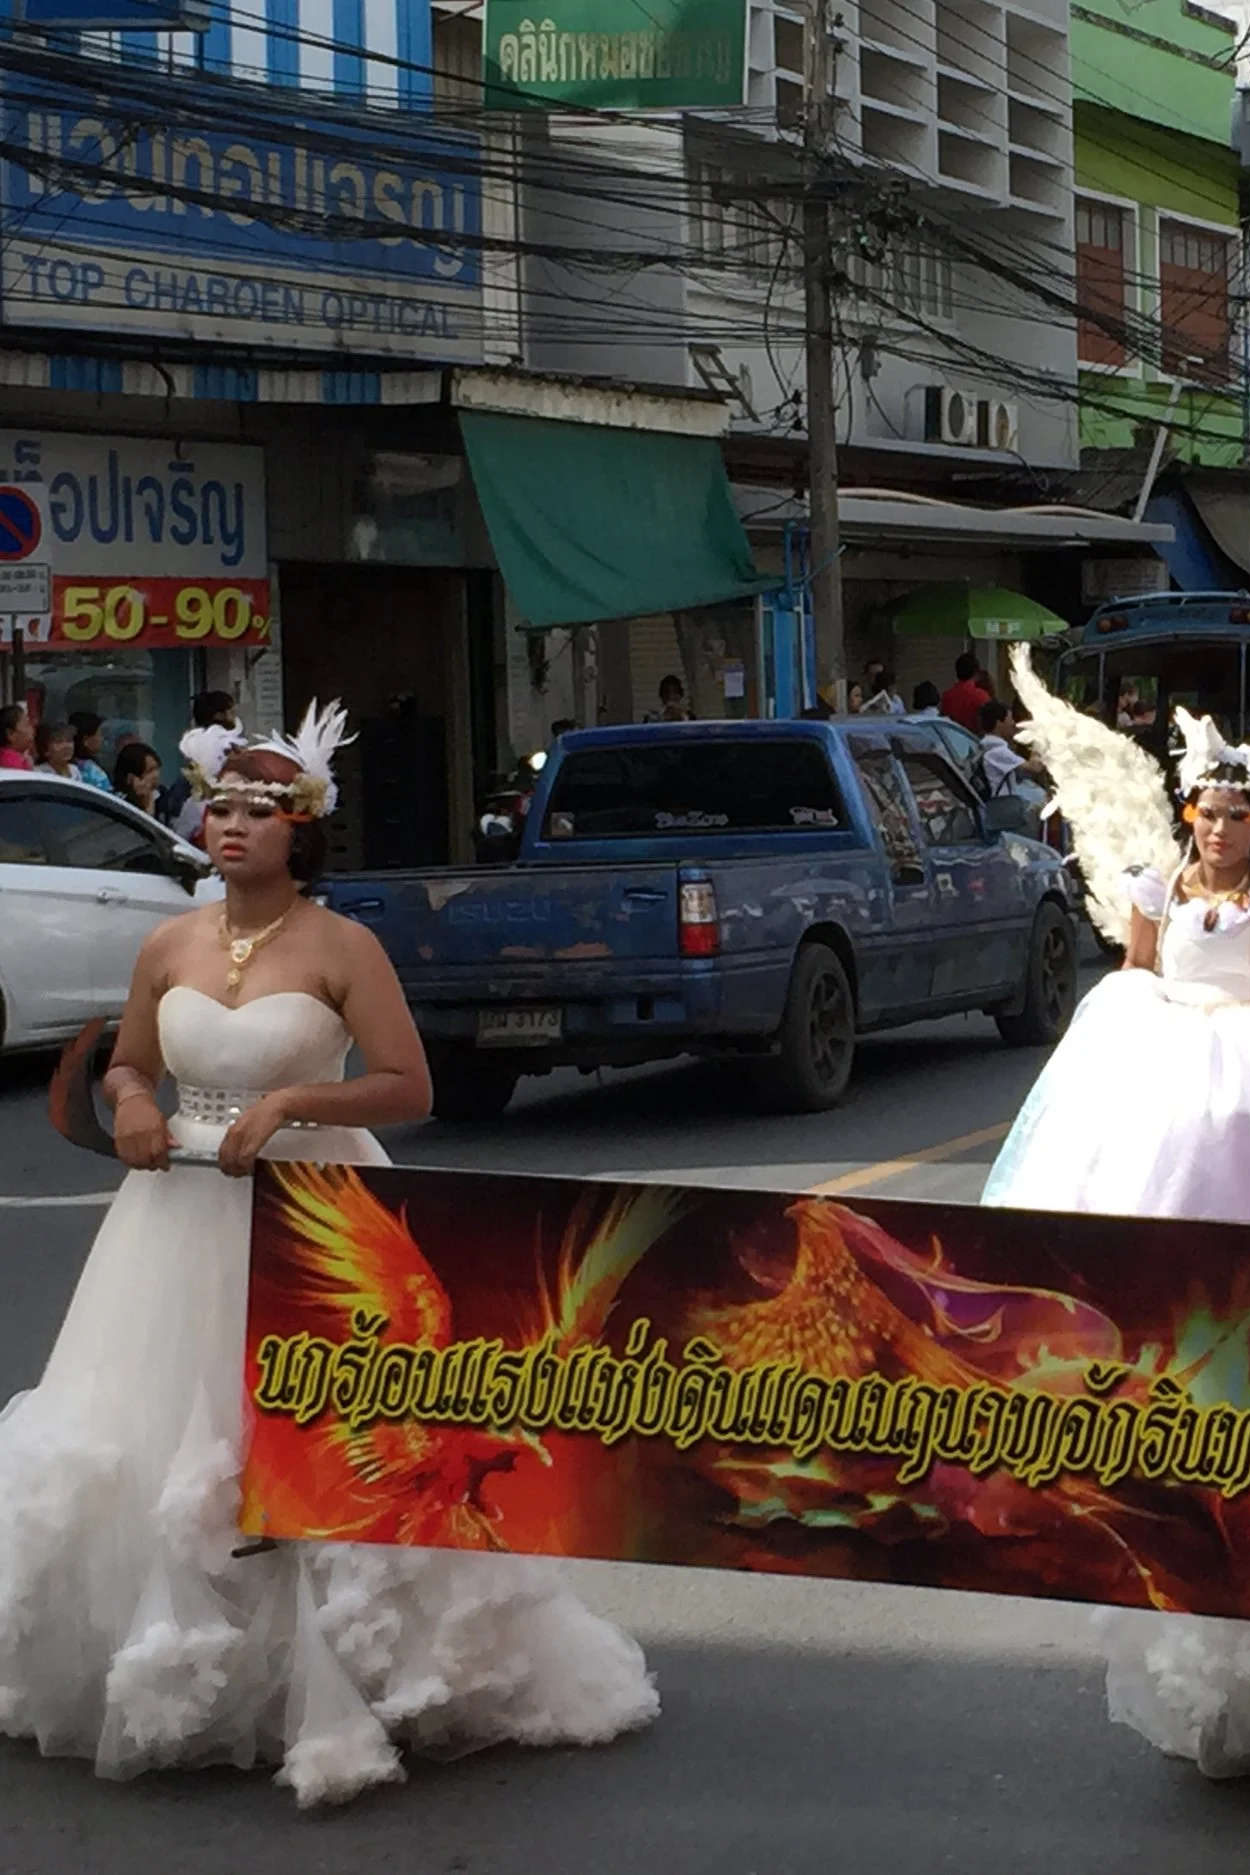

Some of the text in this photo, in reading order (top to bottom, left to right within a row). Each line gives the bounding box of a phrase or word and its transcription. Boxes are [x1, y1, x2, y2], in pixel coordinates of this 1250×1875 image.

[21, 254, 459, 340] TOP CHAROEN OPTICAL
